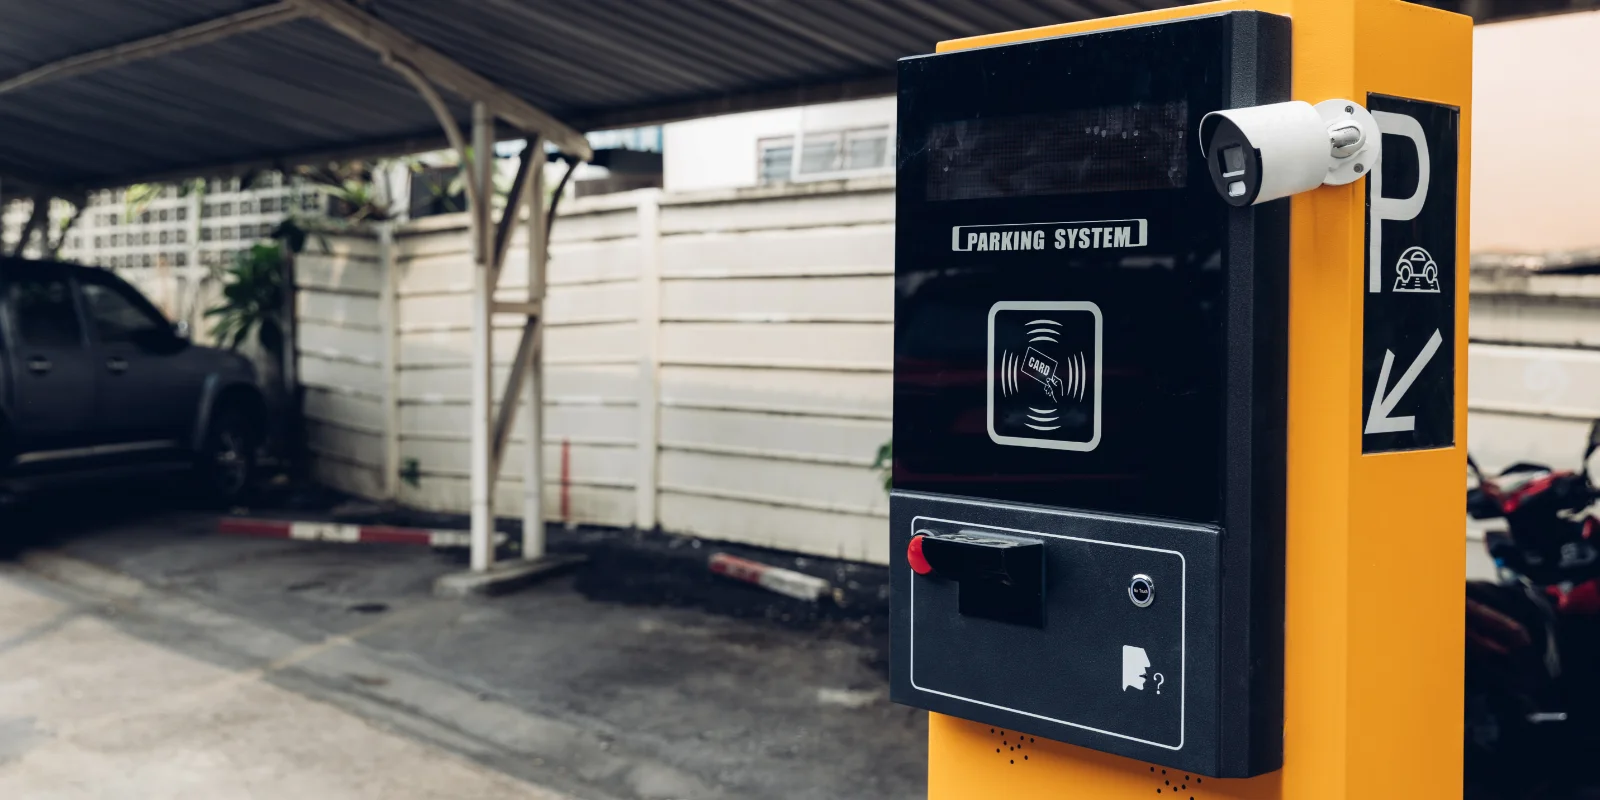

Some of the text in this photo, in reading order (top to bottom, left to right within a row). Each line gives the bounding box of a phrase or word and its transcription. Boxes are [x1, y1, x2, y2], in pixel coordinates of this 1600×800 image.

[1369, 109, 1431, 294] P
[967, 226, 1131, 251] PARKING SYSTEM
[1028, 356, 1051, 377] CARD
